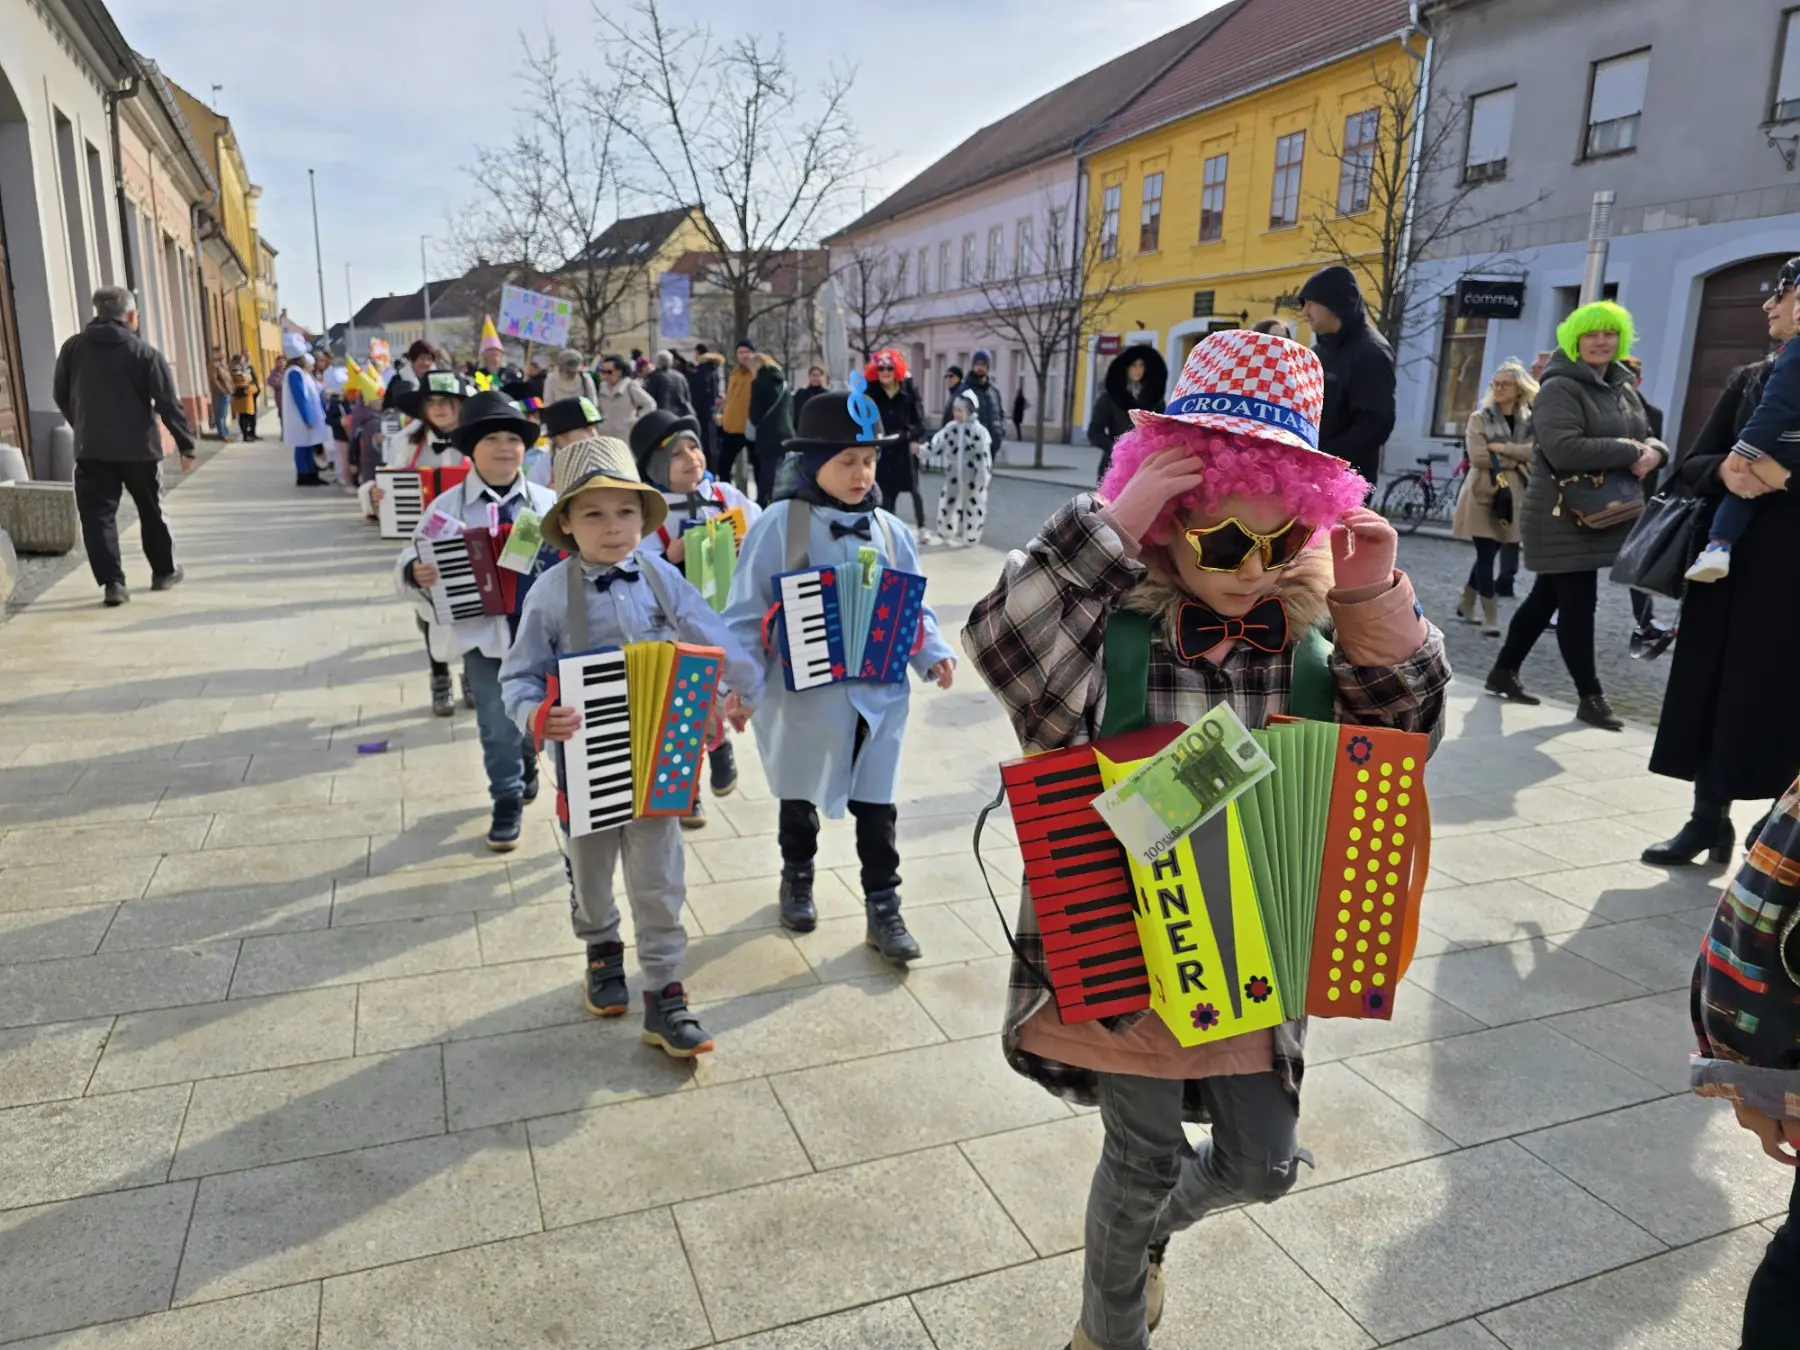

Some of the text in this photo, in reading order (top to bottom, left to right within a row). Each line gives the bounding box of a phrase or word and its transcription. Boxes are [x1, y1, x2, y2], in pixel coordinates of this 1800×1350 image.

[1181, 397, 1299, 429] CROATIA
[1174, 719, 1224, 761] 100
[1151, 847, 1208, 994] HNER
